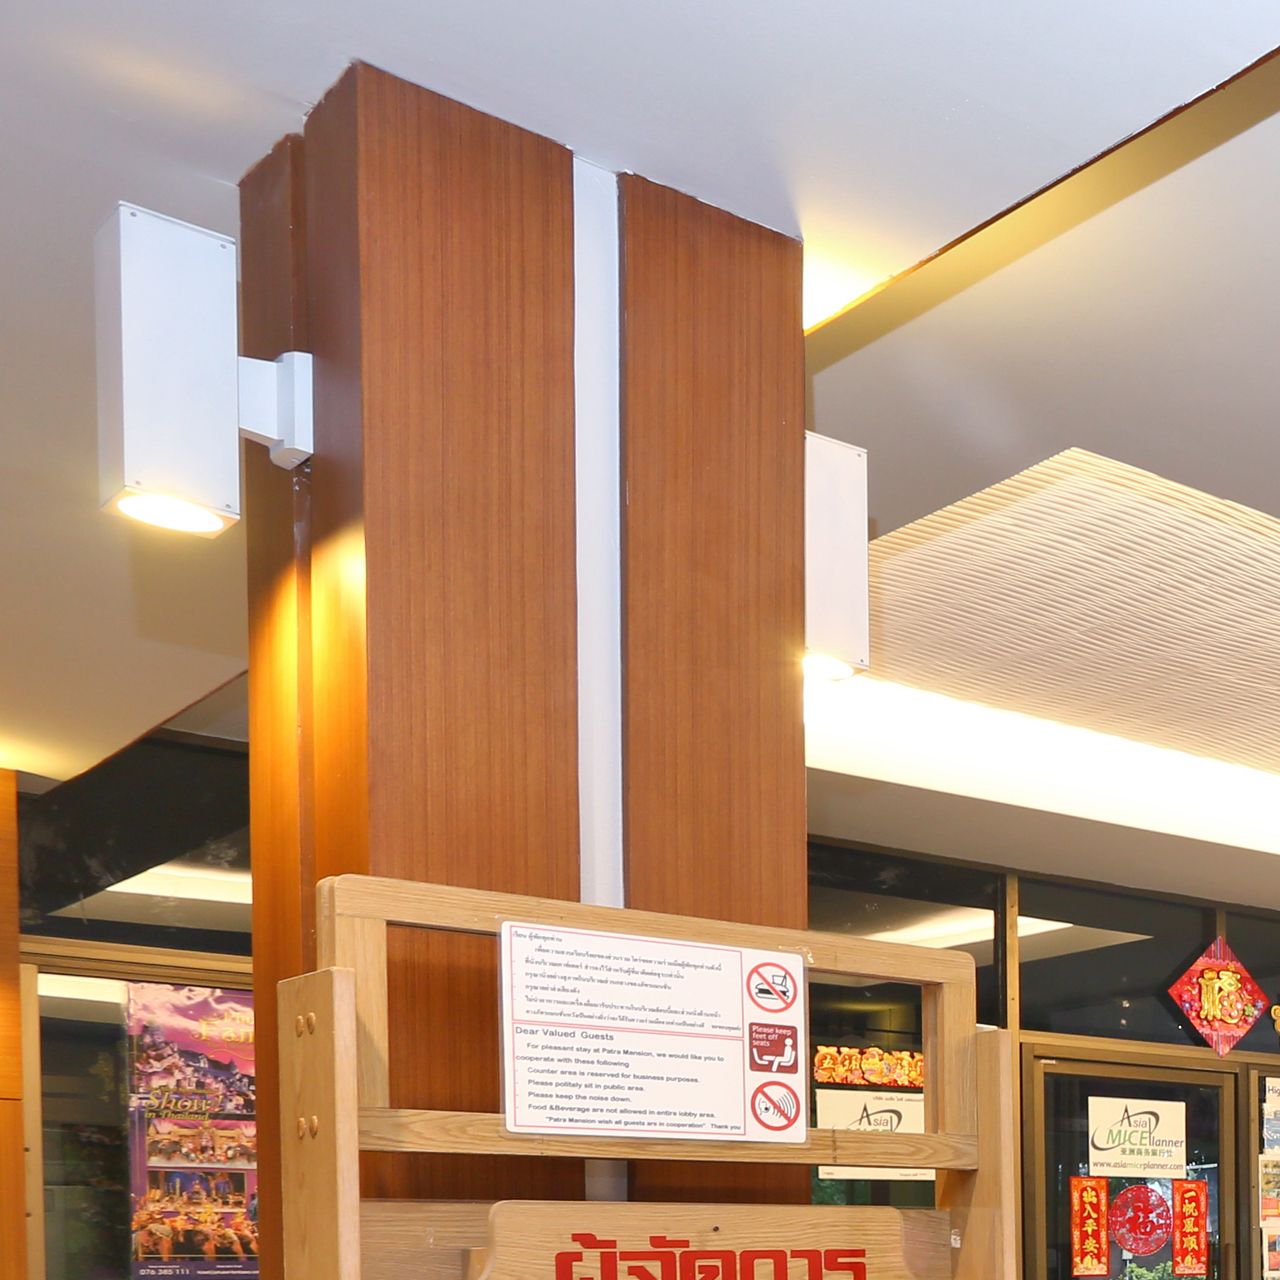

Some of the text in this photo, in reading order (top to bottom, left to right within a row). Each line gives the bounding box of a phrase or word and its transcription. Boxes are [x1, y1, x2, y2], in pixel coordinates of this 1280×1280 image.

[515, 1026, 614, 1041] Dear Valued Guests
[858, 1102, 889, 1127] Asia
[1120, 1104, 1148, 1127] Asia
[1106, 1128, 1149, 1146] MICE
